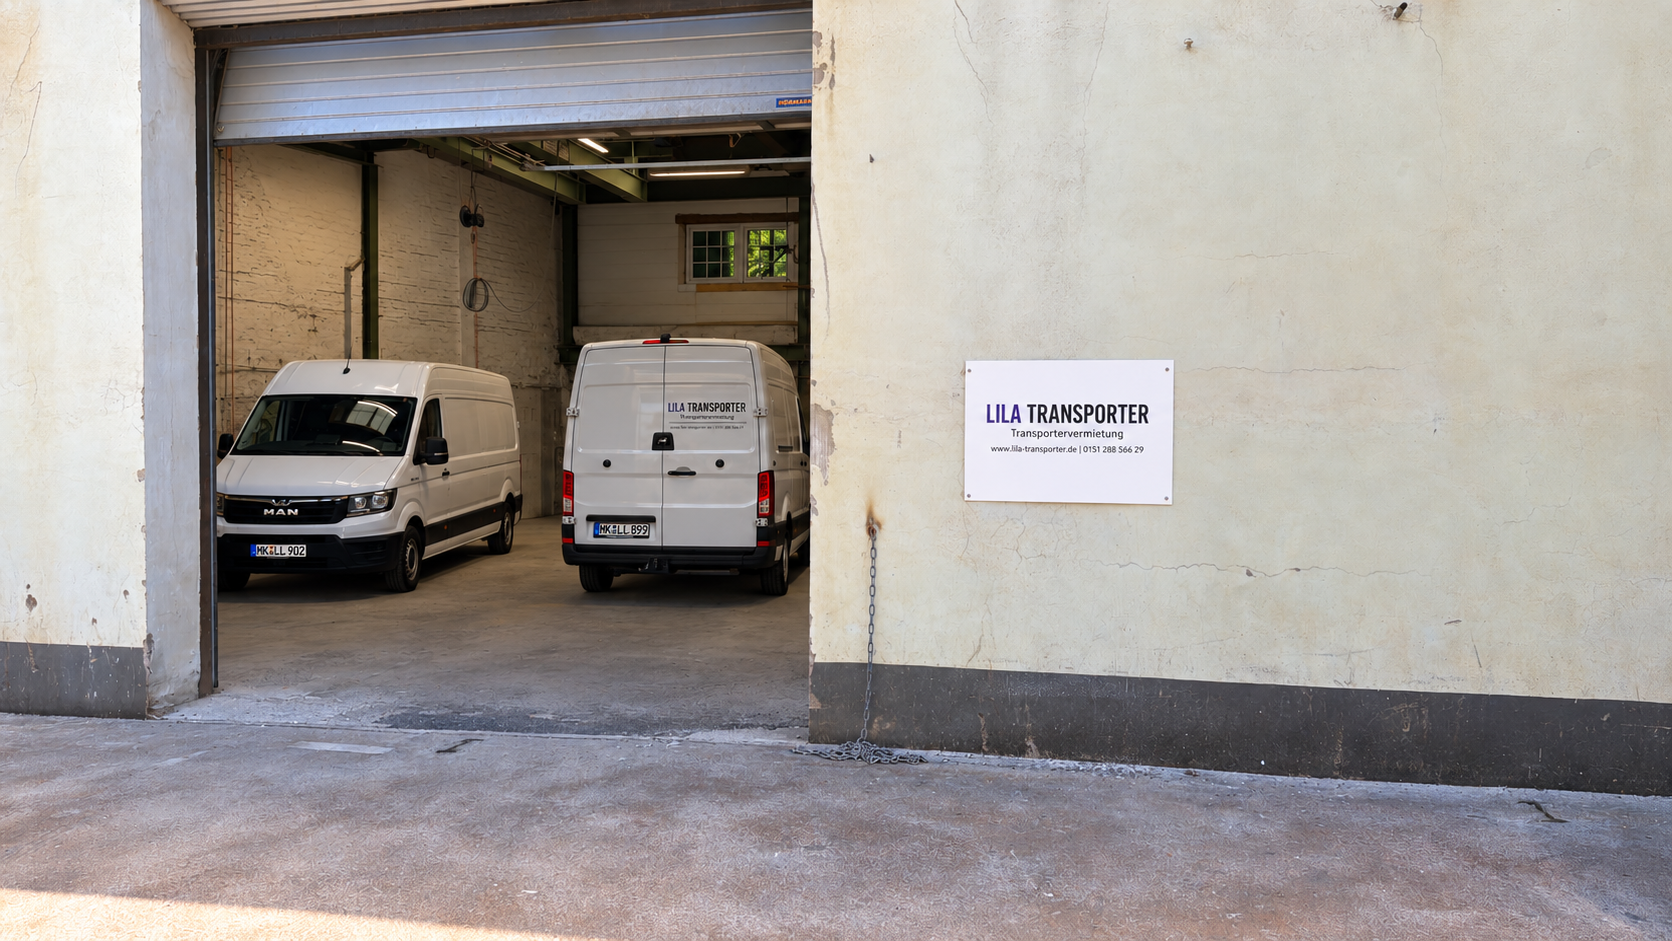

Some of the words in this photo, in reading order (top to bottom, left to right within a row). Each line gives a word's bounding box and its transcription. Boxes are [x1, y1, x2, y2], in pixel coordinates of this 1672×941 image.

[668, 402, 685, 413] LILA
[687, 402, 747, 413] TRANSPORTER
[986, 404, 1022, 423] LILA
[1026, 404, 1149, 424] TRANSPORTER
[1011, 428, 1124, 440] Transportervermietung
[990, 445, 1077, 454] www.lila-transporter.de
[1083, 445, 1100, 454] 0151
[1102, 445, 1117, 454] 288
[1118, 445, 1133, 454] 566
[1134, 445, 1145, 454] 29
[263, 508, 299, 516] MAN
[287, 545, 305, 556] 902
